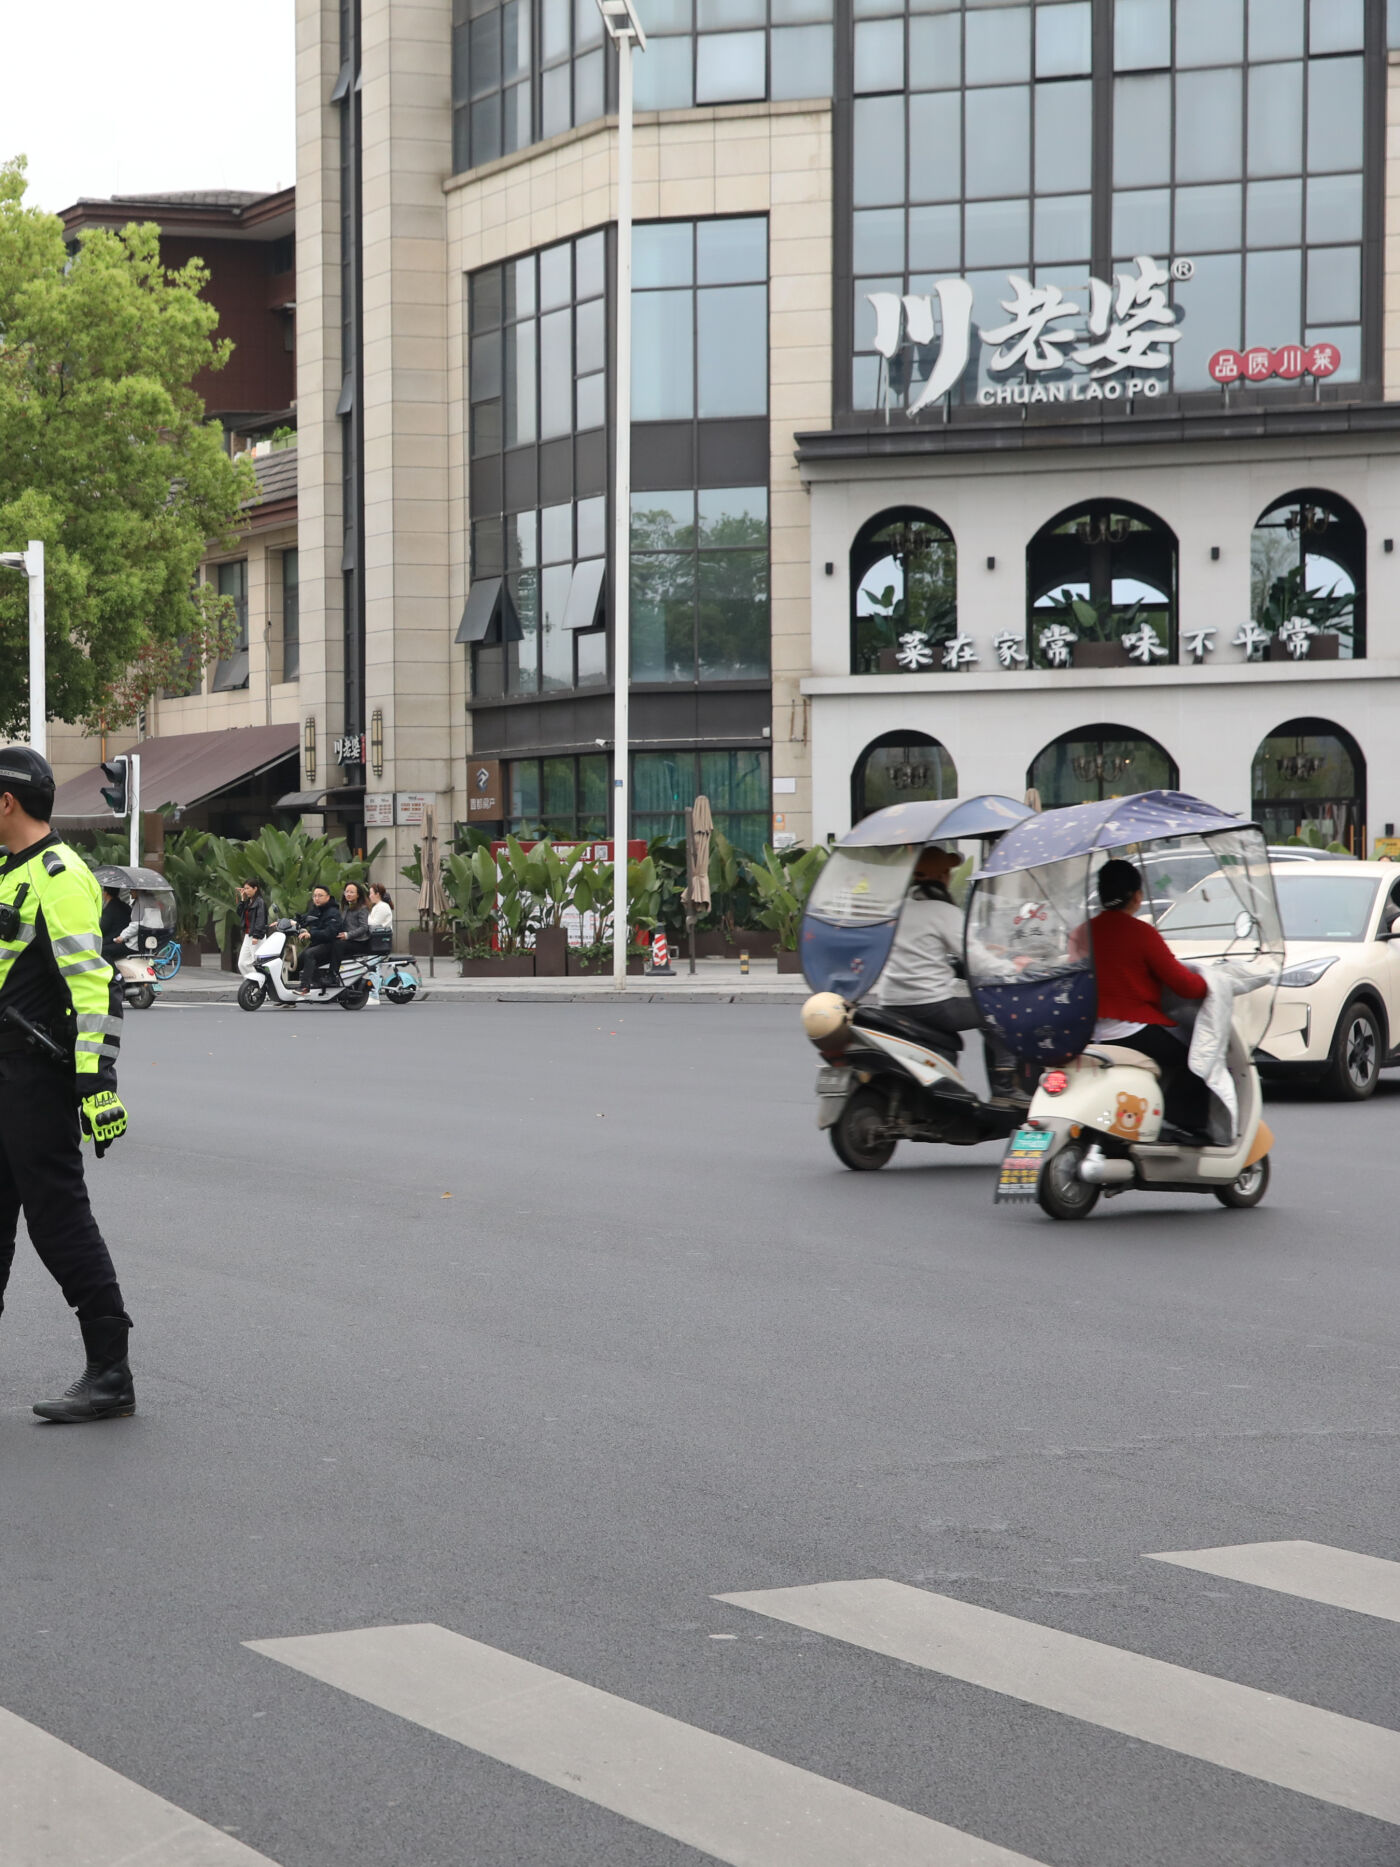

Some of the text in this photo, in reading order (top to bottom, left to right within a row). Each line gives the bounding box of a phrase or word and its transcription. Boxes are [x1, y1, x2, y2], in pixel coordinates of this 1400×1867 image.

[865, 256, 1182, 418] 川老婆
[1214, 348, 1334, 378] 品质川菜
[977, 377, 1161, 406] CHUAN LAO PO
[895, 616, 1320, 672] 菜在家常 味不平常
